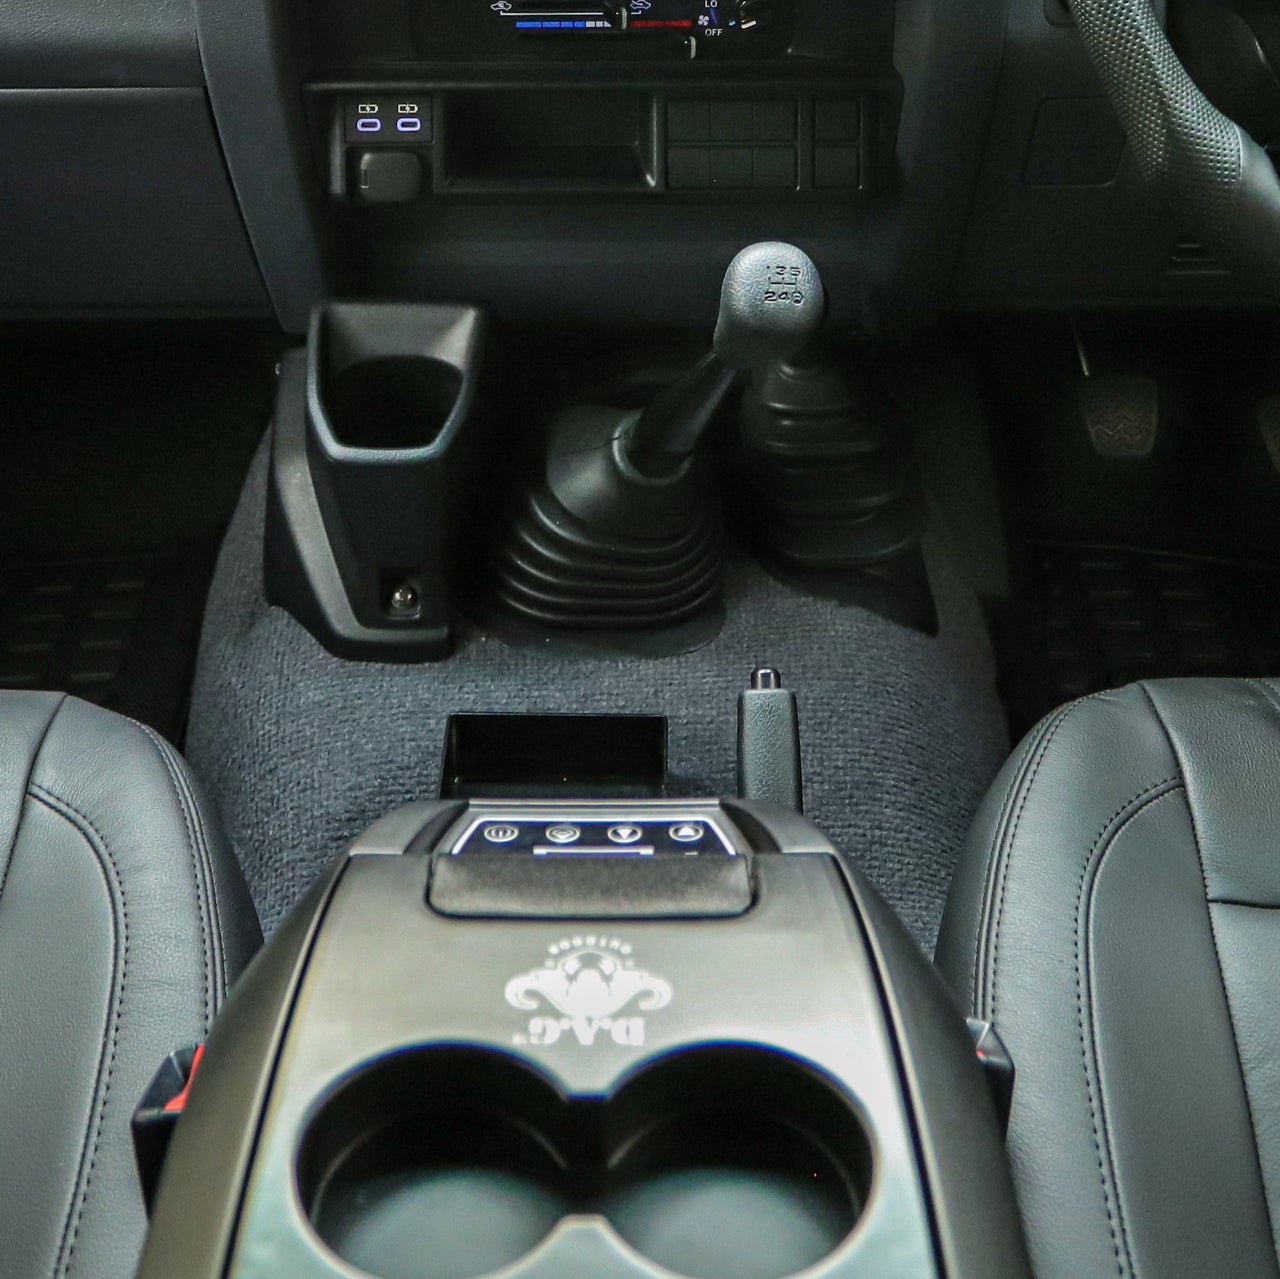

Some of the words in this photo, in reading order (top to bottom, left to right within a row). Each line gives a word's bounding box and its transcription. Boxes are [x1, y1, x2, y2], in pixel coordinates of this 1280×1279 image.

[704, 0, 718, 8] LO
[704, 28, 723, 37] OFF
[764, 290, 777, 304] 2
